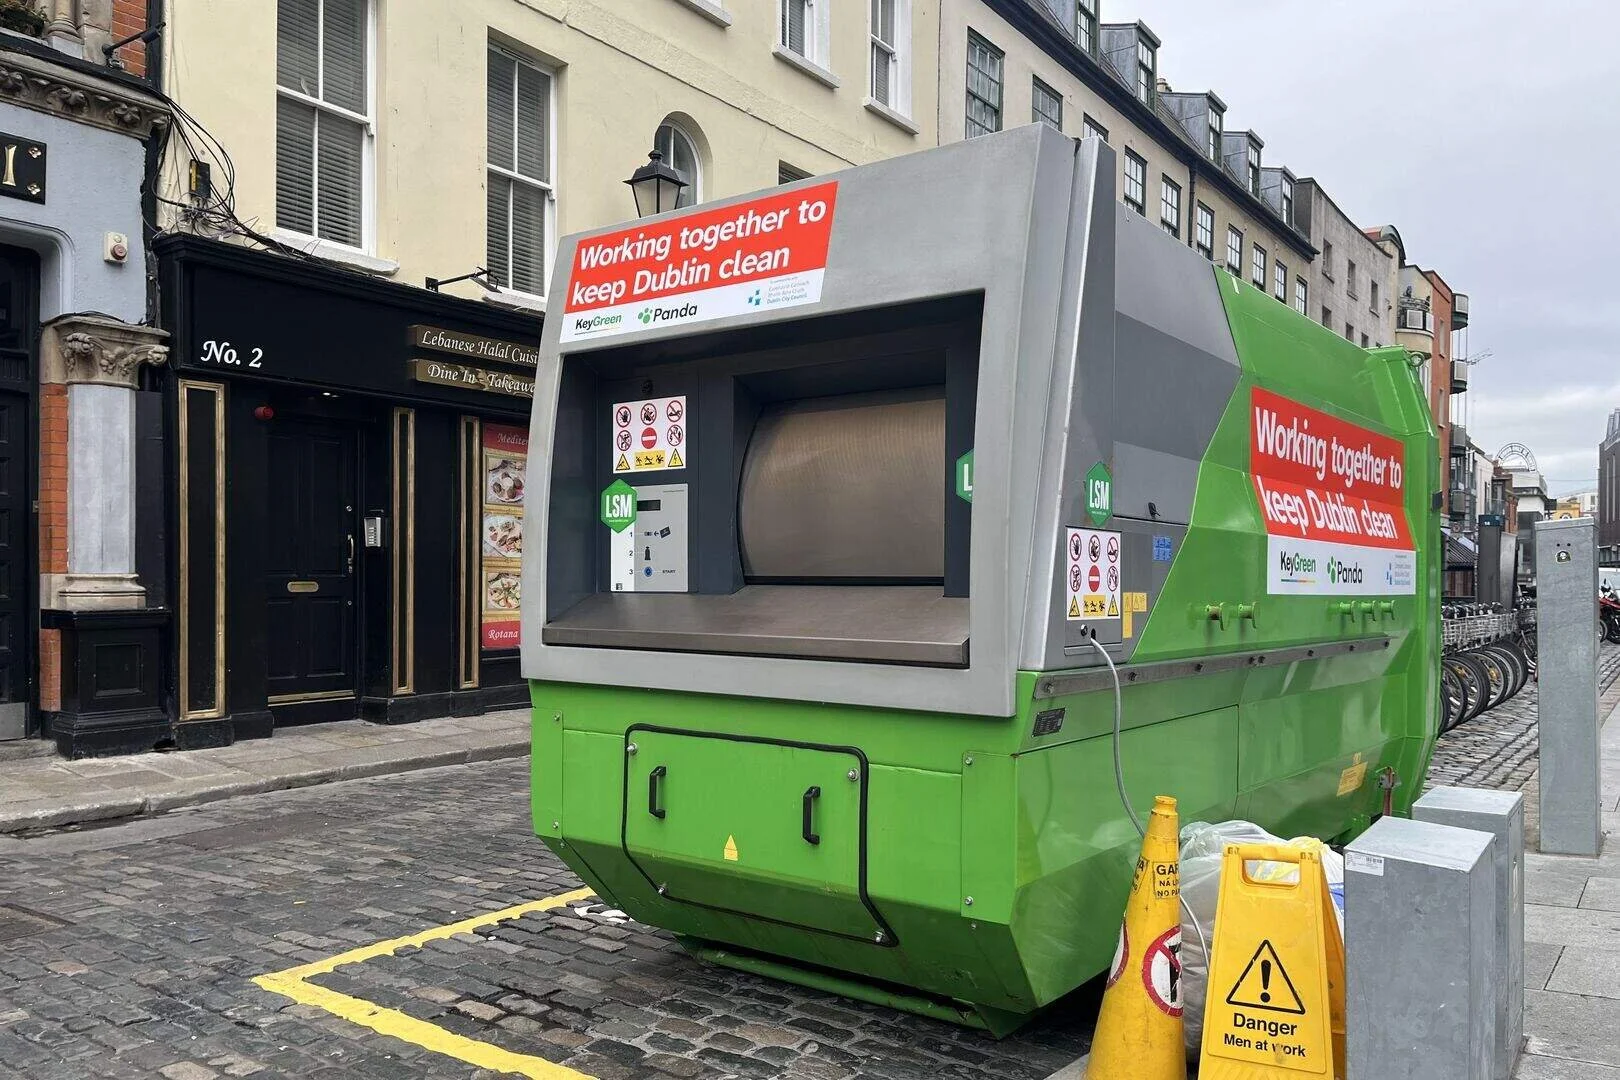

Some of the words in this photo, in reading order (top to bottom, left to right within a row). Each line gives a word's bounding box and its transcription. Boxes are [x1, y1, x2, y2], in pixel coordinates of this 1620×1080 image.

[580, 233, 672, 269] Working
[679, 209, 790, 251] together
[797, 200, 826, 224] to
[571, 279, 626, 306] keep
[632, 257, 711, 296] Dublin
[718, 247, 790, 279] clean
[575, 314, 622, 330] KeyGreen
[653, 303, 698, 321] Panda
[200, 340, 241, 365] No.
[248, 347, 263, 368] 2
[422, 331, 474, 352] Lebanese
[477, 341, 511, 359] Halal
[427, 364, 459, 380] Dine
[462, 369, 476, 384] In
[1255, 407, 1326, 481] Working
[1331, 437, 1387, 488] together
[1389, 455, 1401, 490] to
[605, 494, 633, 518] LSM
[1089, 478, 1110, 510] LSM
[1256, 475, 1309, 536] keep
[1305, 489, 1361, 535] Dublin
[1361, 500, 1399, 540] clean
[1280, 551, 1317, 577] KeyGreen
[1337, 562, 1363, 584] Panda
[487, 629, 519, 641] Rotana
[1233, 1012, 1298, 1037] Danger
[1224, 1033, 1251, 1048] Men
[1255, 1040, 1268, 1051] at
